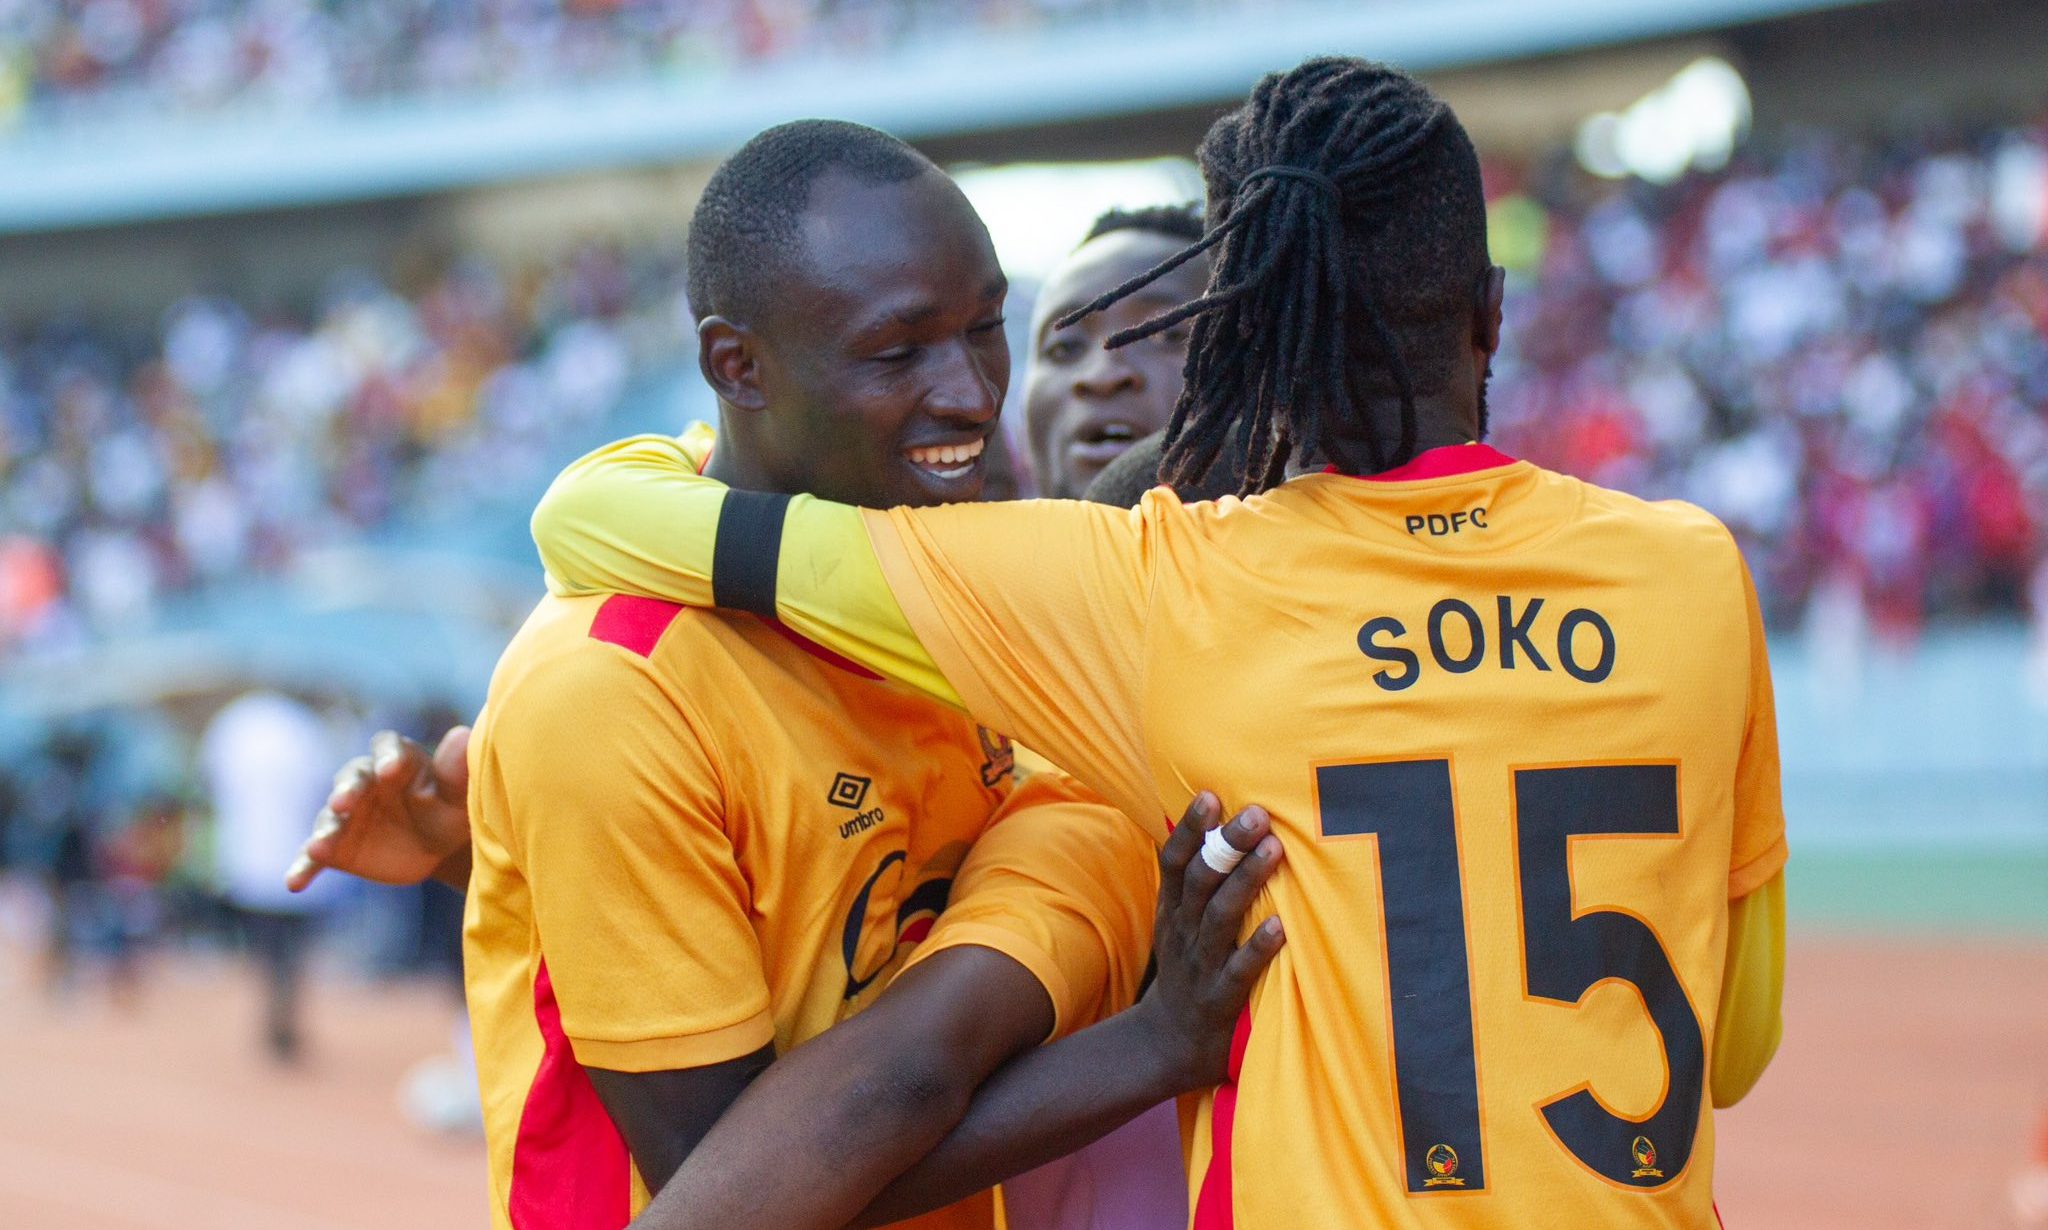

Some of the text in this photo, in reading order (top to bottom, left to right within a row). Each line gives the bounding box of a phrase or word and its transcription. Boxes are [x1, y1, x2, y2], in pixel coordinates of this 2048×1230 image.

[1405, 507, 1488, 536] PDFC
[1356, 595, 1616, 692] SOKO
[839, 807, 884, 839] umbro
[1312, 755, 1708, 1196] 15
